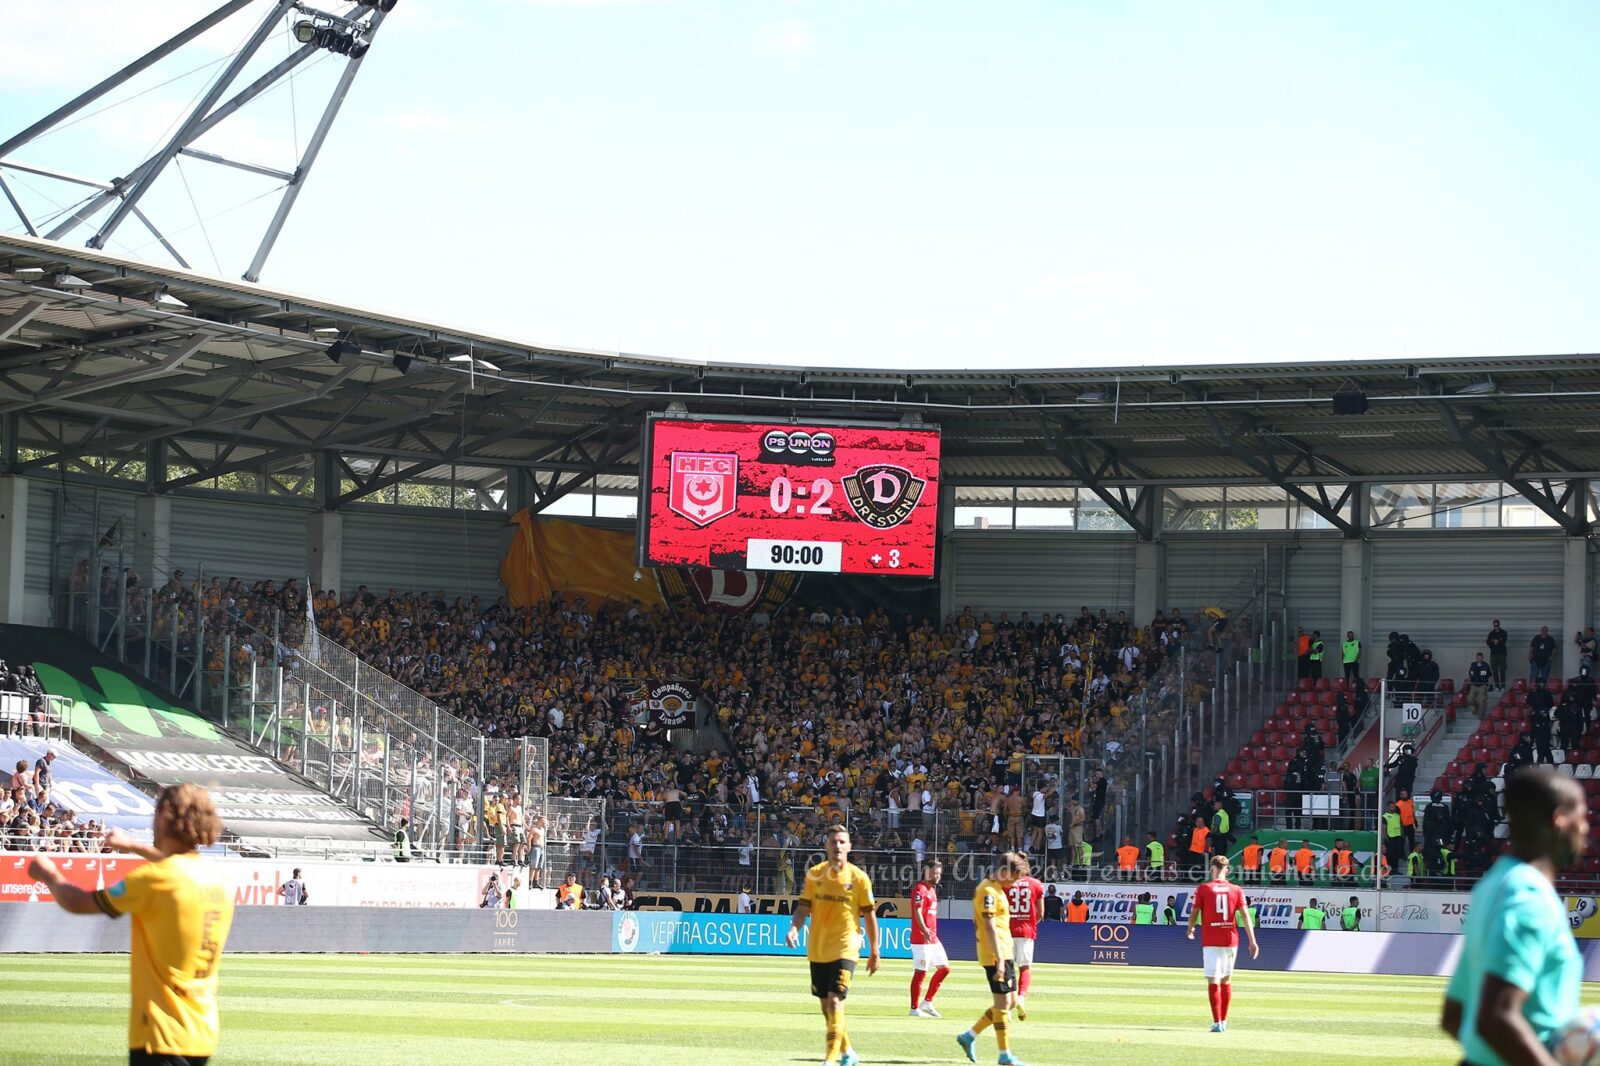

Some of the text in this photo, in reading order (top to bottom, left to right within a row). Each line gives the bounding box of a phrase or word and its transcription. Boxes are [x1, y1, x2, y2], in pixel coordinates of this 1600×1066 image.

[768, 437, 830, 448] PS UNION
[678, 456, 731, 473] HFC
[770, 476, 833, 515] 0:2
[852, 496, 914, 527] DRESDEN
[771, 545, 824, 566] 90:00
[889, 549, 900, 568] 3
[1406, 708, 1419, 720] 10
[115, 751, 287, 775] MOBILEBET
[1, 882, 32, 894] unsere
[1080, 891, 1158, 900] Wohn-Centm
[1008, 887, 1031, 913] 33
[1215, 893, 1228, 922] 4
[1441, 903, 1470, 915] ZUS
[495, 910, 518, 928] 100
[1318, 902, 1373, 919] Köster
[1405, 904, 1430, 920] Pils
[1091, 924, 1129, 942] 100
[494, 937, 516, 948] JAHRE
[1093, 950, 1126, 960] JAHRE
